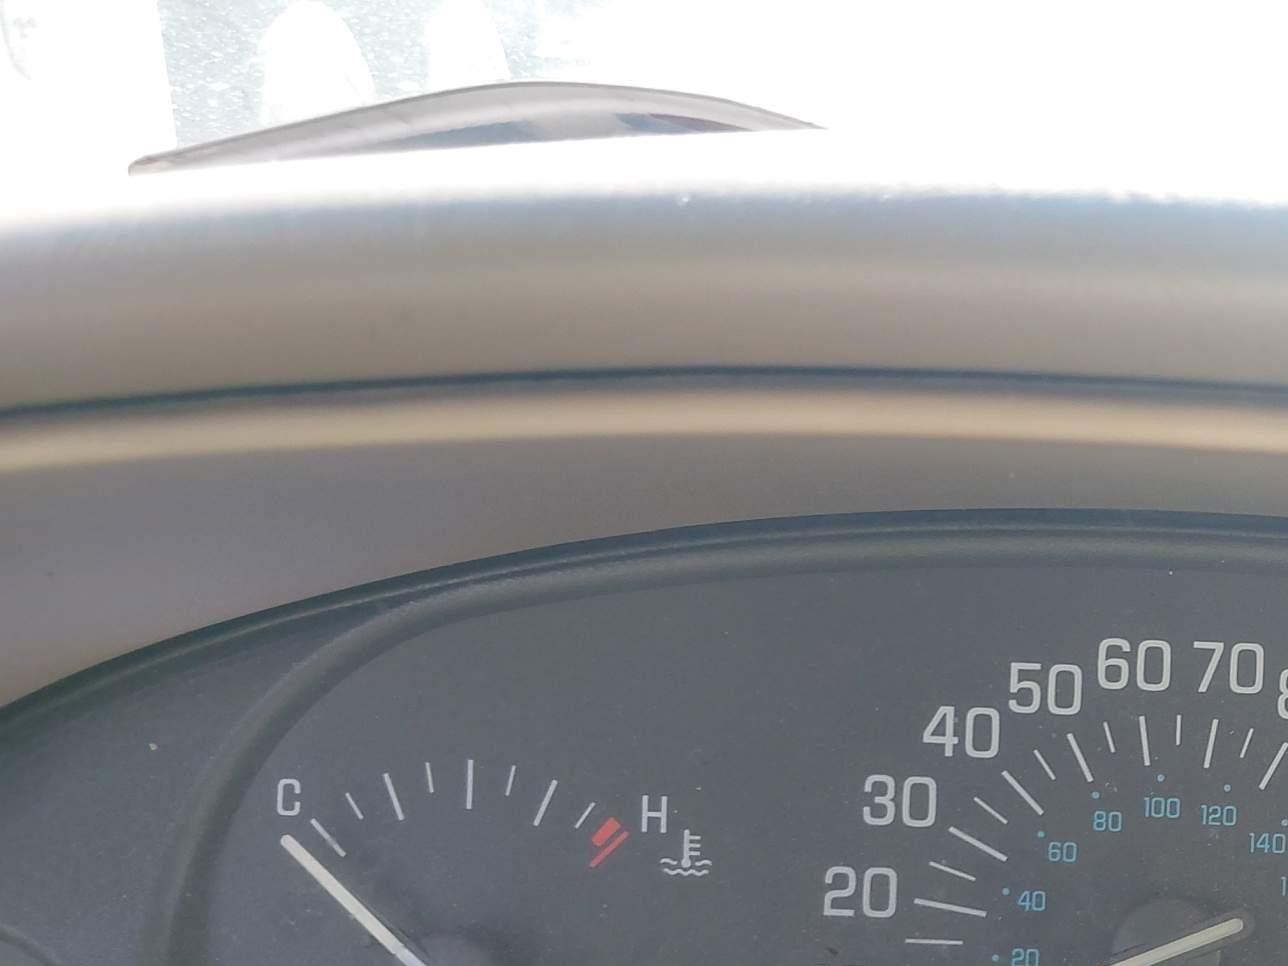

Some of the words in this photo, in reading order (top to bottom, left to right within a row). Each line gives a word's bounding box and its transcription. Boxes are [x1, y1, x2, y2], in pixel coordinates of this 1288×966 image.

[1096, 638, 1171, 690] 60
[1192, 641, 1265, 694] 70
[1008, 663, 1082, 715] 50
[923, 707, 1000, 759] 40
[278, 779, 302, 817] C
[642, 795, 668, 832] H
[862, 776, 936, 827] 30
[1144, 797, 1180, 818] 100
[1201, 804, 1237, 825] 120
[1092, 811, 1123, 831] 80
[1048, 841, 1077, 862] 60
[1249, 831, 1286, 854] 140
[823, 866, 898, 918] 20
[1017, 891, 1046, 912] 40
